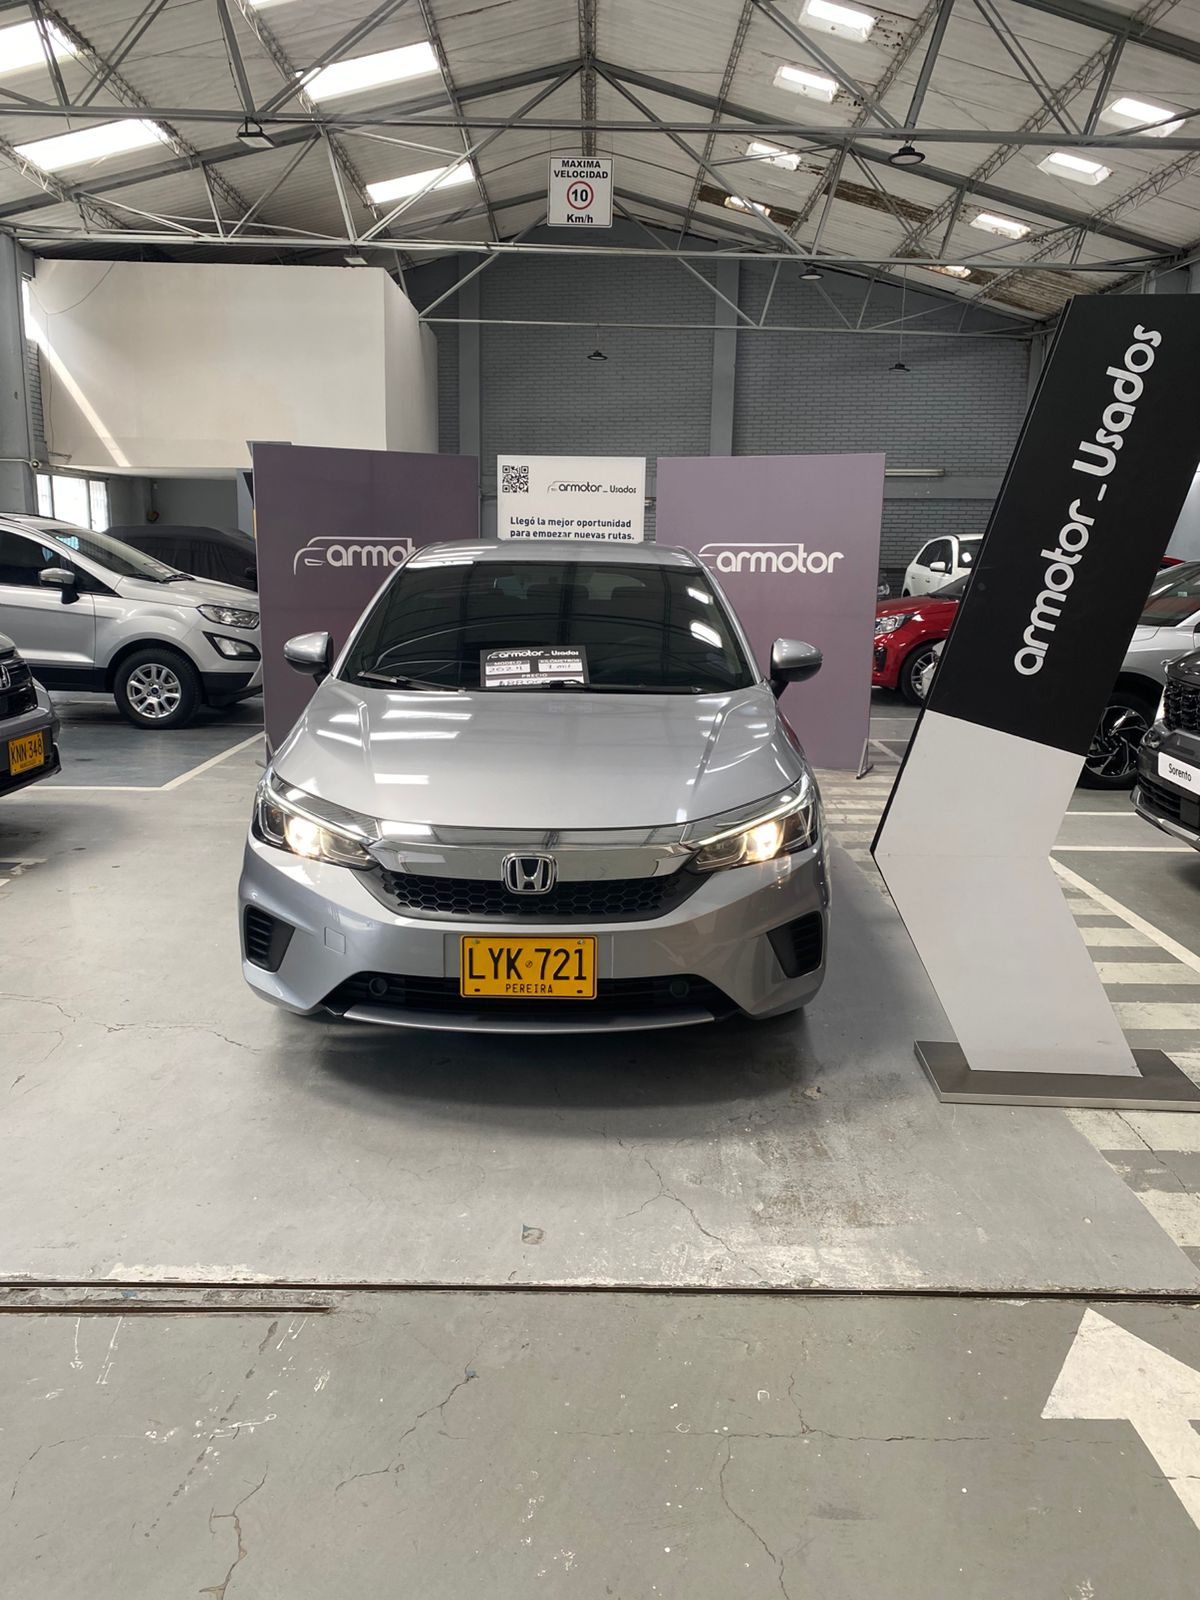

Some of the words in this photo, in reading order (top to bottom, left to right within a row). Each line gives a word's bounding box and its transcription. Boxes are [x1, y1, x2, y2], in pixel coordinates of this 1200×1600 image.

[561, 160, 601, 168] MAXIMA
[554, 170, 609, 179] VELOCIDAD
[571, 189, 588, 202] 10
[566, 214, 594, 223] Km/h
[1071, 324, 1162, 478] Usados
[510, 516, 535, 527] Llegó
[537, 517, 546, 525] la
[548, 518, 575, 528] mejor
[576, 519, 632, 528] oportunidad
[510, 529, 530, 538] para
[574, 531, 606, 539] nuevas
[608, 531, 635, 540] rutas.
[326, 537, 416, 567] armot
[716, 543, 845, 574] armotor
[1168, 763, 1192, 782] Sorento
[468, 948, 523, 980] LYK
[534, 948, 587, 981] 721
[505, 984, 553, 994] PEREIRA
